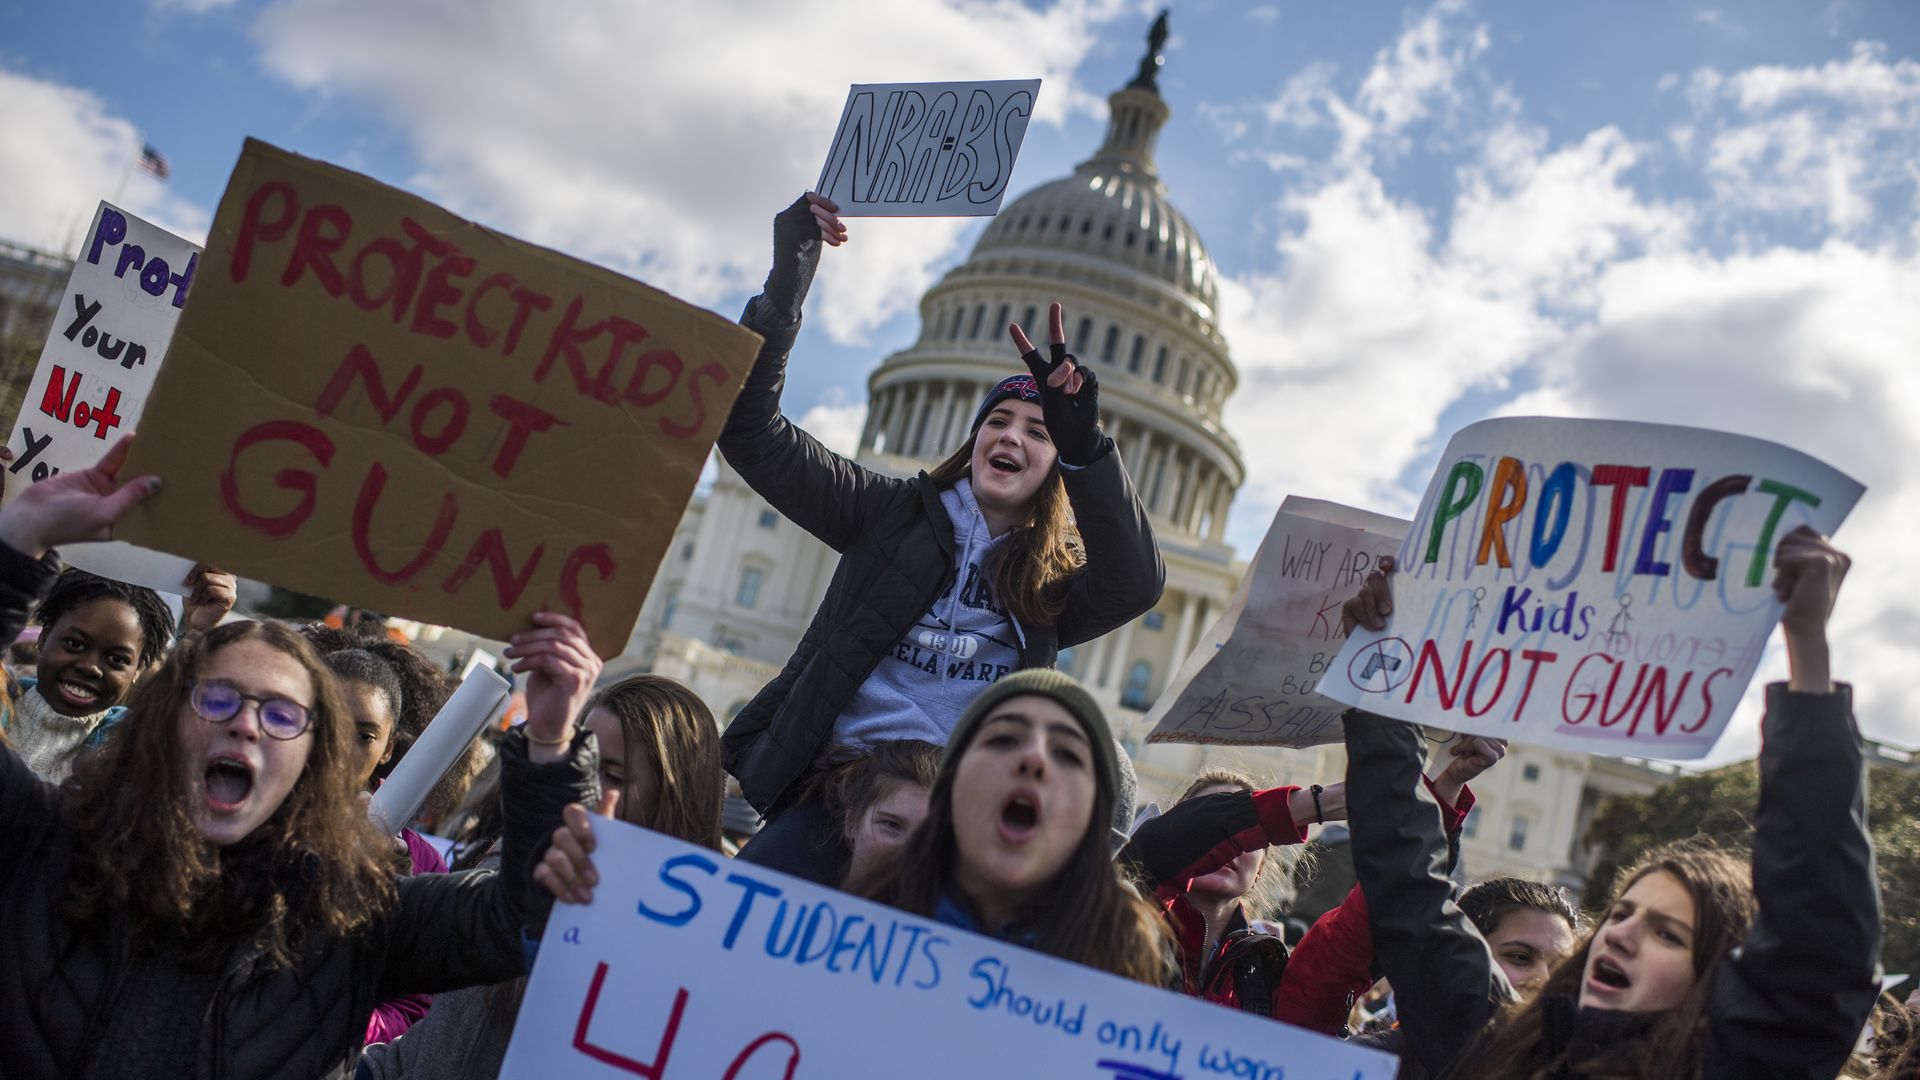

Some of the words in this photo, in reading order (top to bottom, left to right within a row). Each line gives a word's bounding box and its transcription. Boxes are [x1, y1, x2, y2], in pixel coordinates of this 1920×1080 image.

[63, 293, 147, 370] Your
[229, 180, 553, 357] PROTECT
[533, 294, 731, 440] KIDS
[39, 364, 121, 440] Not
[314, 343, 570, 480] NOT
[8, 427, 60, 484] Yo
[1281, 533, 1333, 583] WHY
[1423, 455, 1822, 588] PROTECT
[1496, 585, 1597, 642] Kids
[1403, 638, 1558, 723] NOT
[1561, 651, 1734, 738] GUNS
[562, 925, 582, 945] a
[637, 853, 952, 990] STUDENTS
[967, 955, 1087, 1036] Should
[1096, 1020, 1183, 1076] only
